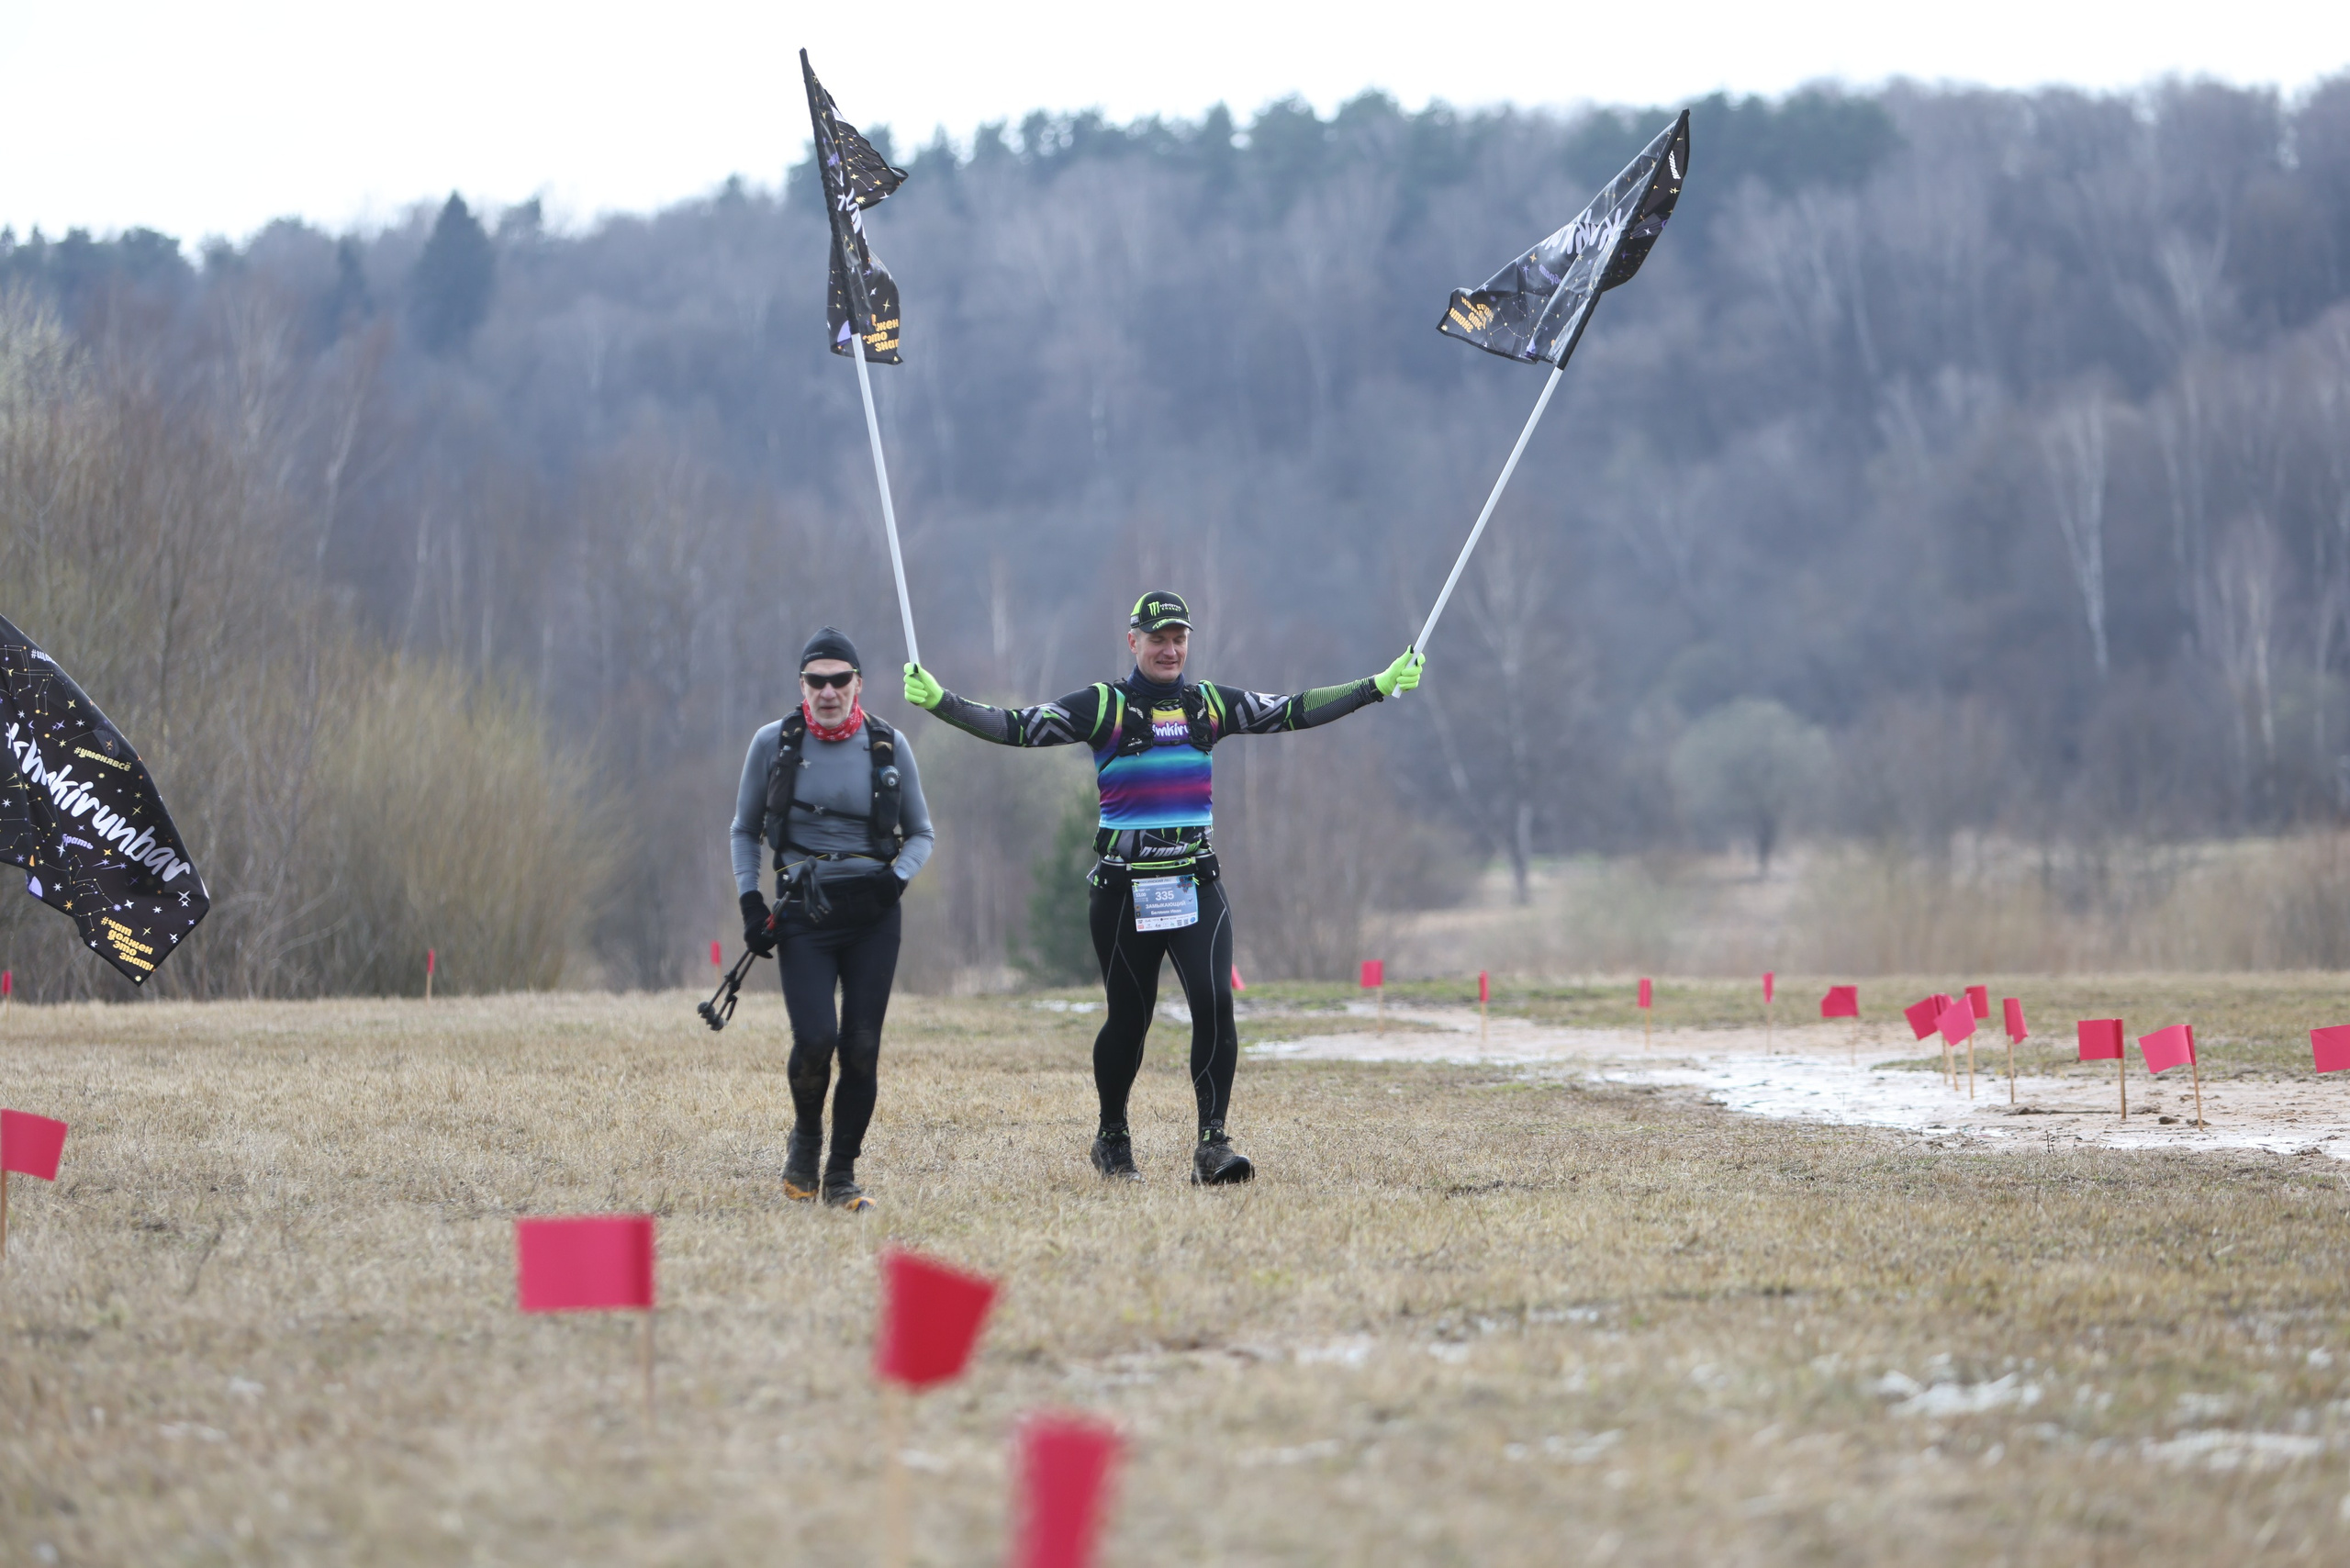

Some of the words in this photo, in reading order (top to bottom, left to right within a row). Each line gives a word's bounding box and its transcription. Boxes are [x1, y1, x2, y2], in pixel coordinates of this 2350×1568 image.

[1155, 890, 1174, 901] 335
[101, 916, 132, 936] #чат
[107, 929, 154, 955] должен
[112, 940, 137, 956] это
